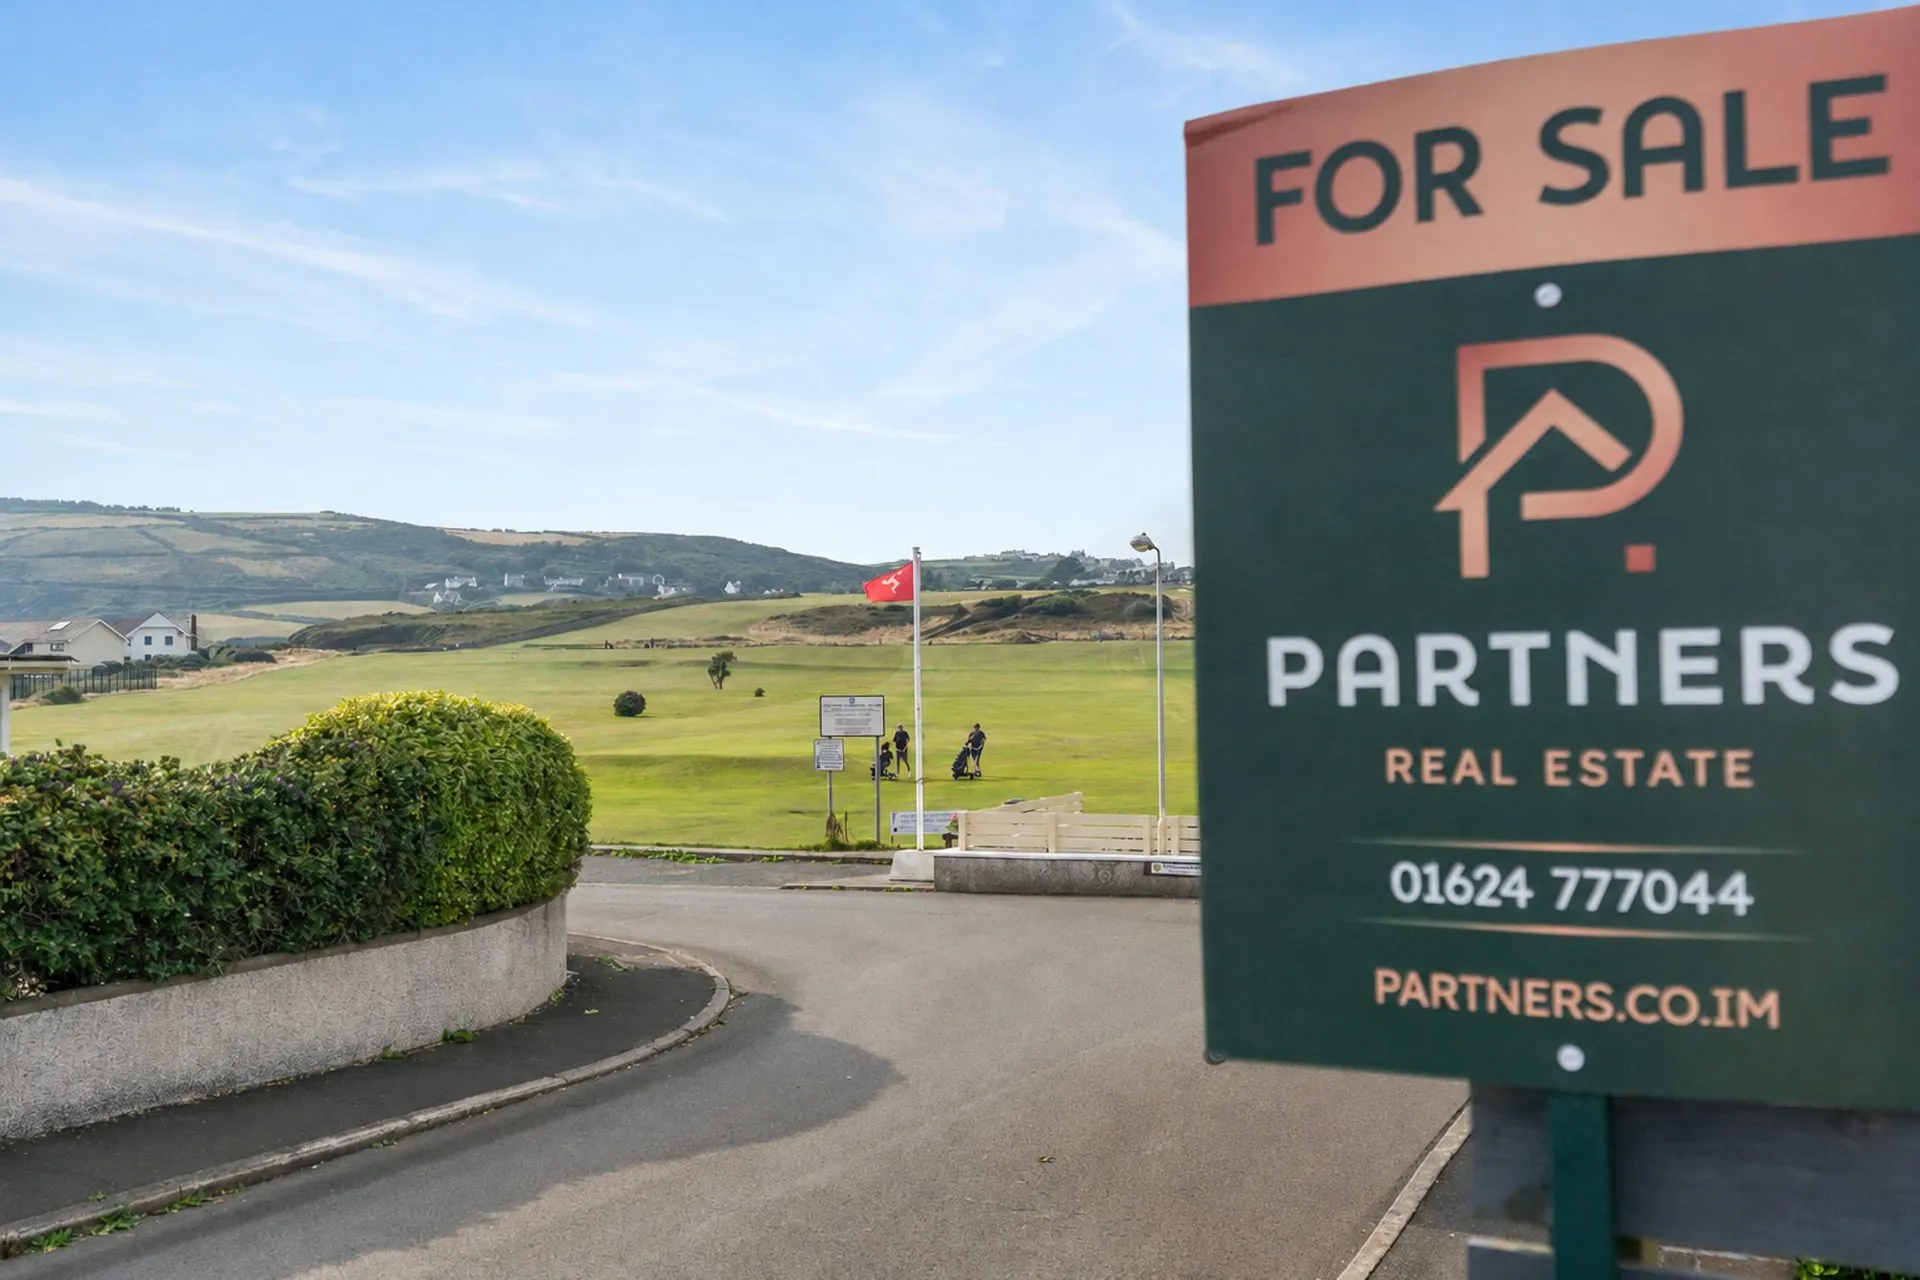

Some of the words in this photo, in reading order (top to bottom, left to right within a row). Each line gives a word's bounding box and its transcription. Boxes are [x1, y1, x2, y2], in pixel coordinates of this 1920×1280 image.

[1255, 126, 1484, 246] FOR
[1538, 73, 1891, 206] SALE
[1266, 622, 1901, 708] PARTNERS
[1385, 748, 1517, 786] REAL
[1543, 749, 1755, 789] ESTATE
[1389, 861, 1534, 910] 01624
[1550, 867, 1754, 917] 777044
[1373, 967, 1781, 1030] PARTNERS.CO.IM
